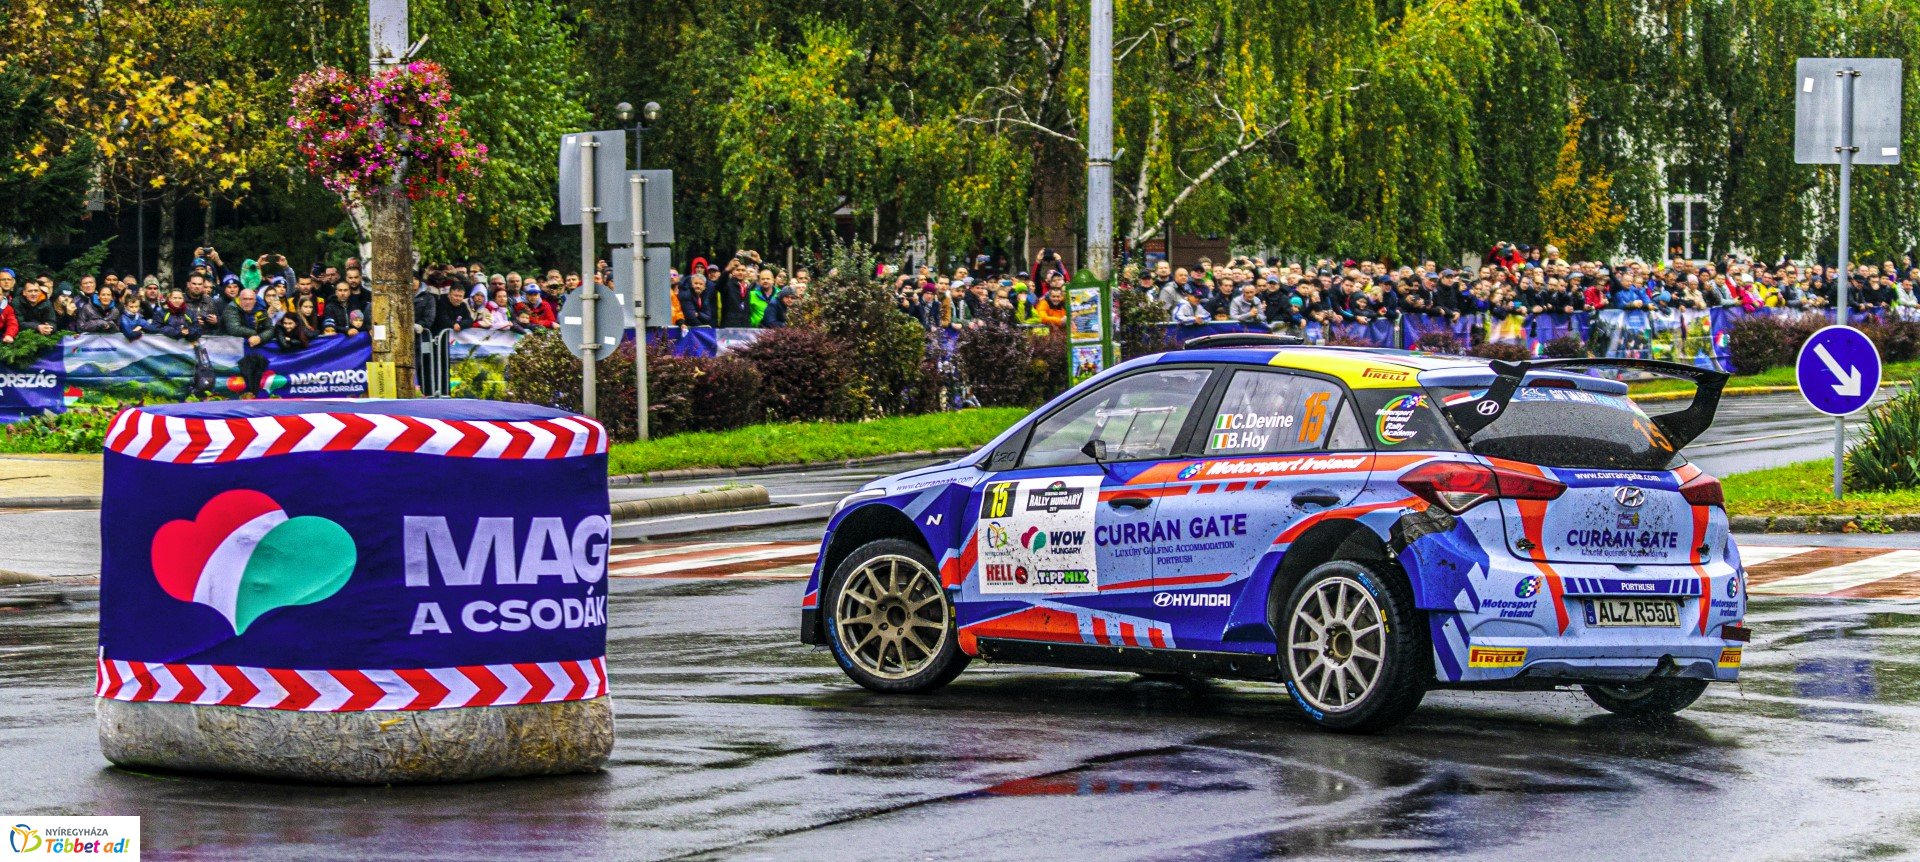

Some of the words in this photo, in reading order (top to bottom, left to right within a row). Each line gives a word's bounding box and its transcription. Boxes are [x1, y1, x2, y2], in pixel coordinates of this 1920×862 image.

[0, 369, 57, 388] ORSZÁG
[289, 370, 368, 386] MAGYARO
[1362, 368, 1410, 381] PIRELLI
[289, 386, 297, 394] A
[298, 385, 328, 394] CSODÁK
[330, 382, 364, 393] FORRÁSA
[1298, 392, 1330, 443] 15
[1375, 408, 1414, 418] Motorsport
[1231, 412, 1294, 430] C.Devine
[1385, 422, 1405, 431] Rally
[1382, 429, 1418, 438] Academy
[1632, 418, 1673, 452] 15
[1227, 432, 1270, 451] B.Hoy
[1206, 458, 1305, 475] Motorsport
[1301, 456, 1367, 471] Ireland
[1575, 472, 1660, 482] www.currangate.com
[991, 482, 1012, 518] 15
[1029, 494, 1050, 507] RALLY
[1050, 492, 1083, 506] HUNGARY
[1095, 519, 1181, 547] CURRAN
[1189, 513, 1247, 539] GATE
[1050, 531, 1086, 546] WOW
[1567, 530, 1635, 548] CURRAN
[1640, 531, 1678, 548] GATE
[404, 515, 612, 586] MAG
[1051, 547, 1082, 555] HUNGARY
[1157, 555, 1193, 565] PORTRUSH
[986, 564, 1014, 581] HELL
[1621, 582, 1655, 591] PORTRUSH
[1172, 594, 1231, 607] HYUNDAI
[1481, 599, 1537, 610] Motorsport
[1711, 599, 1738, 608] Motorsport
[409, 602, 452, 635] A
[461, 586, 606, 633] CSODÁK
[1500, 609, 1535, 618] Ireland
[1600, 602, 1632, 622] ALZ
[1634, 602, 1675, 622] R550
[1720, 608, 1738, 617] Ireland
[1471, 649, 1525, 662] PIRELLI
